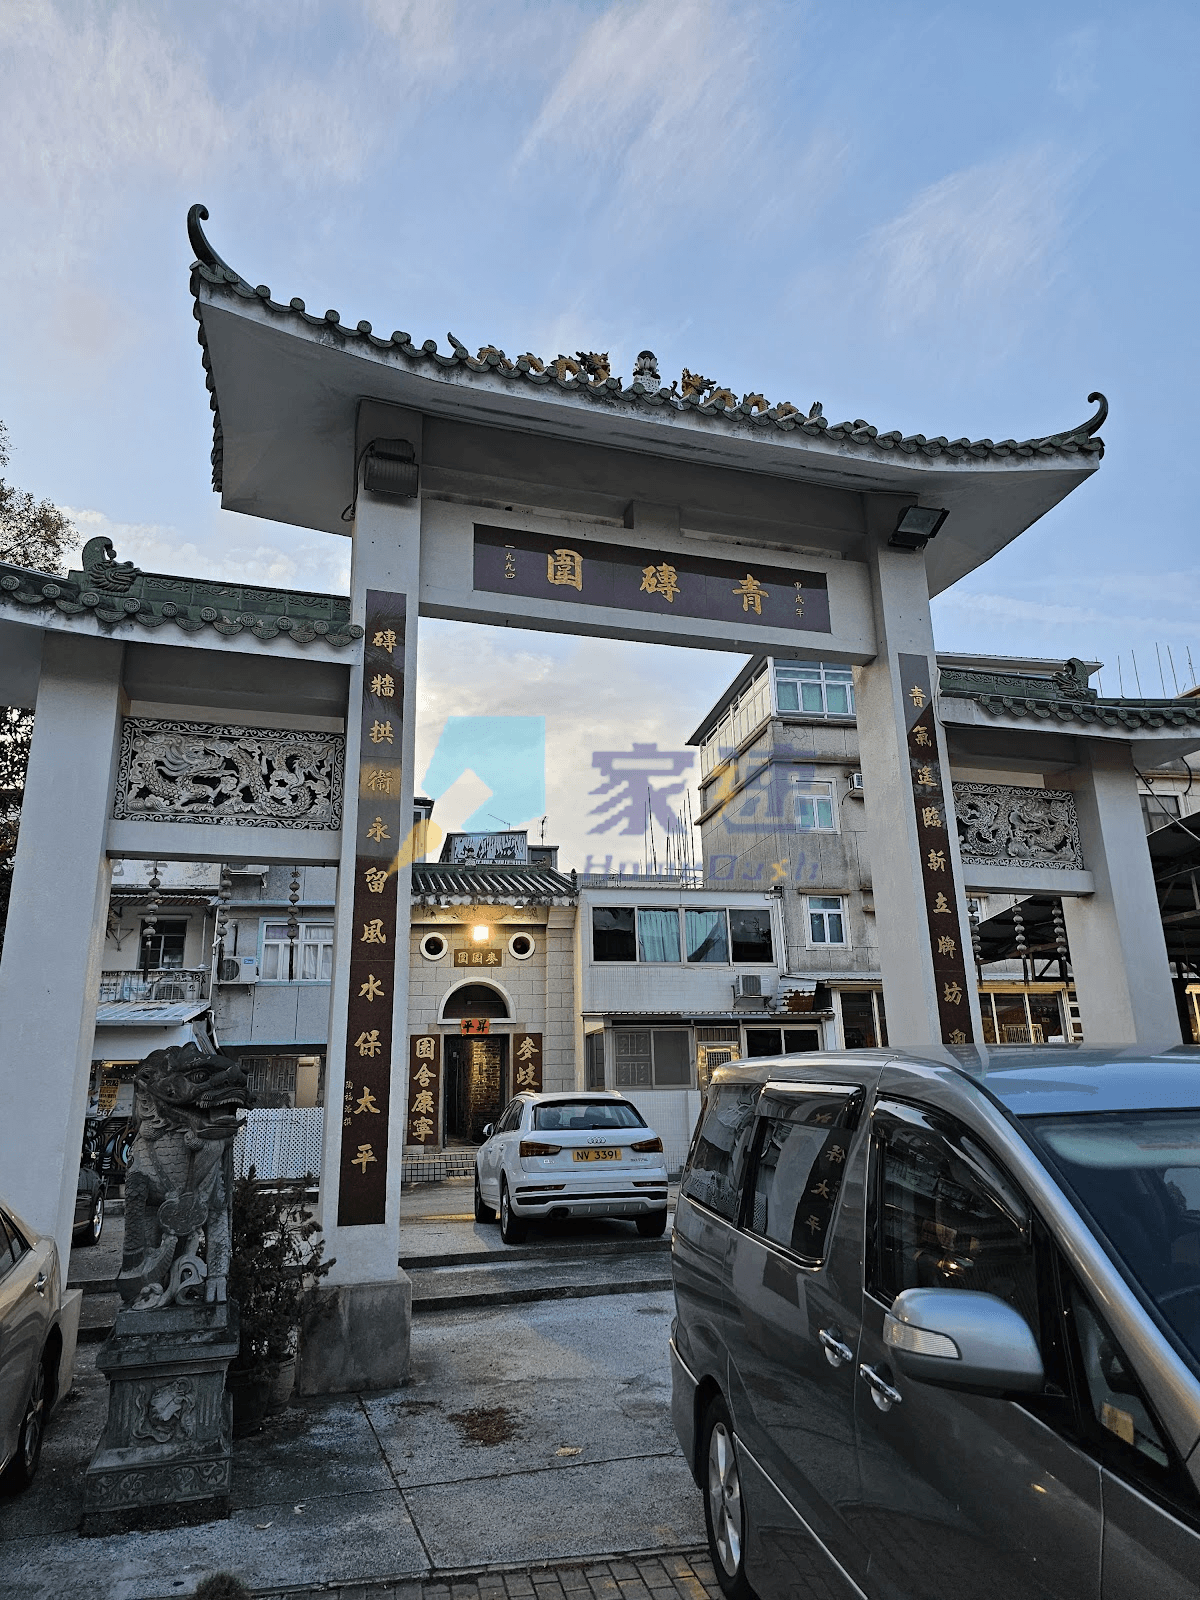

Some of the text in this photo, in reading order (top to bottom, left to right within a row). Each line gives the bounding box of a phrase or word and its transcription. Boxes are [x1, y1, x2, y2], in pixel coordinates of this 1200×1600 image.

[505, 544, 516, 579] 一九九四
[547, 549, 769, 616] 青磚圍
[411, 1037, 437, 1142] 園舍康寧
[576, 1150, 618, 1161] NV 3391
